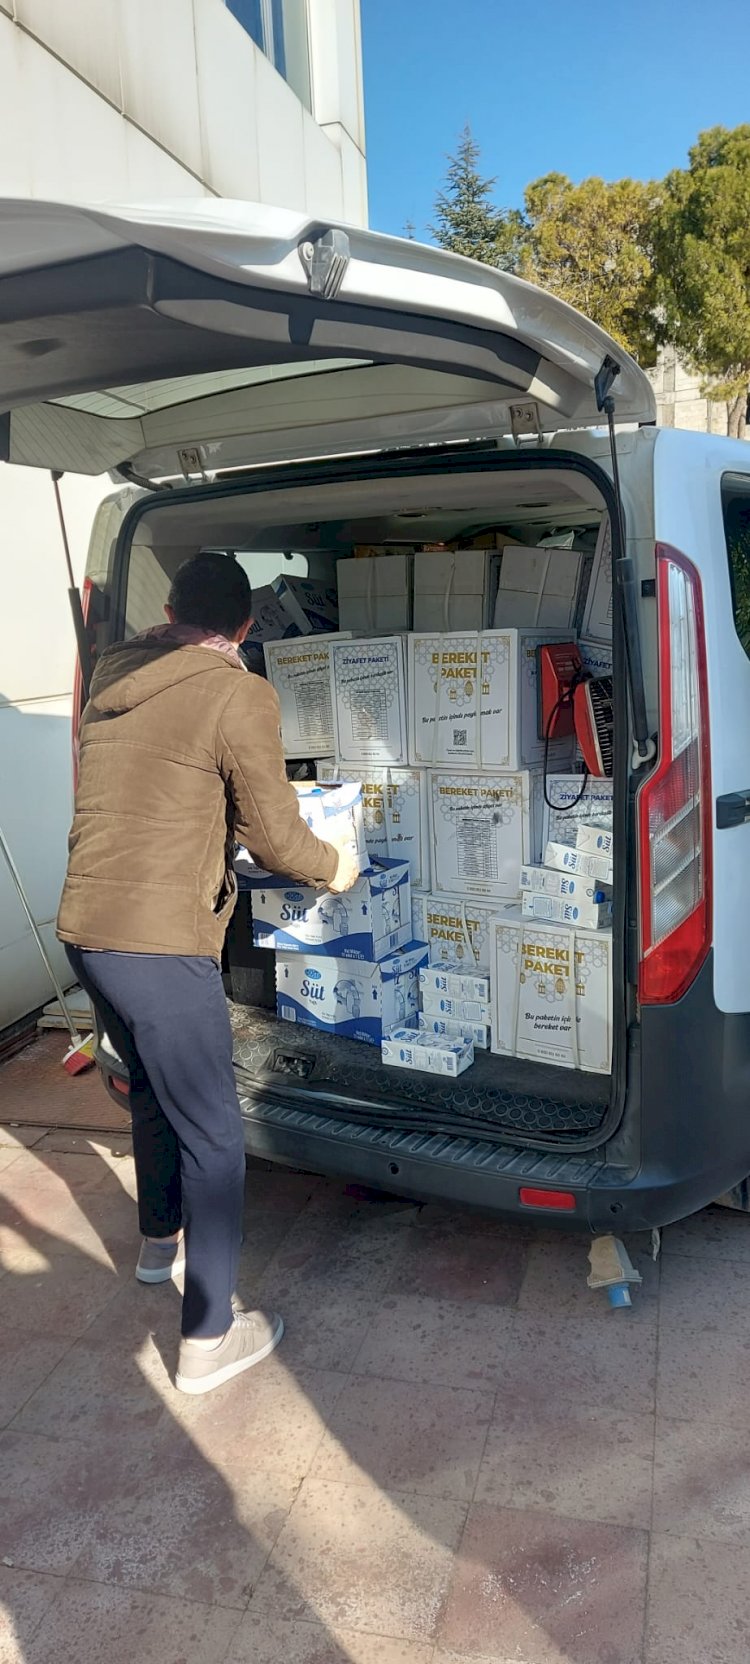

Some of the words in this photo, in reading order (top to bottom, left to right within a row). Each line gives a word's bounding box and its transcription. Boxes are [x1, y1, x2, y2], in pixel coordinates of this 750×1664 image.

[277, 654, 312, 665] BEREKET
[313, 652, 330, 661] PAK
[367, 655, 389, 663] PAKETİ
[440, 667, 478, 678] PAKET
[361, 784, 399, 795] REKET
[439, 786, 478, 796] BEREKET
[480, 787, 513, 798] PAKETİ
[602, 835, 612, 853] Süt
[568, 853, 578, 870] Süt
[560, 878, 569, 894] Süt
[280, 903, 309, 923] Süt
[564, 903, 573, 920] Süt
[524, 959, 569, 976] PAKET
[300, 980, 325, 1000] Süt
[525, 1012, 534, 1020] Bu
[535, 1013, 560, 1021] paketin
[533, 1022, 559, 1030] bereket
[405, 1049, 413, 1065] Süt
